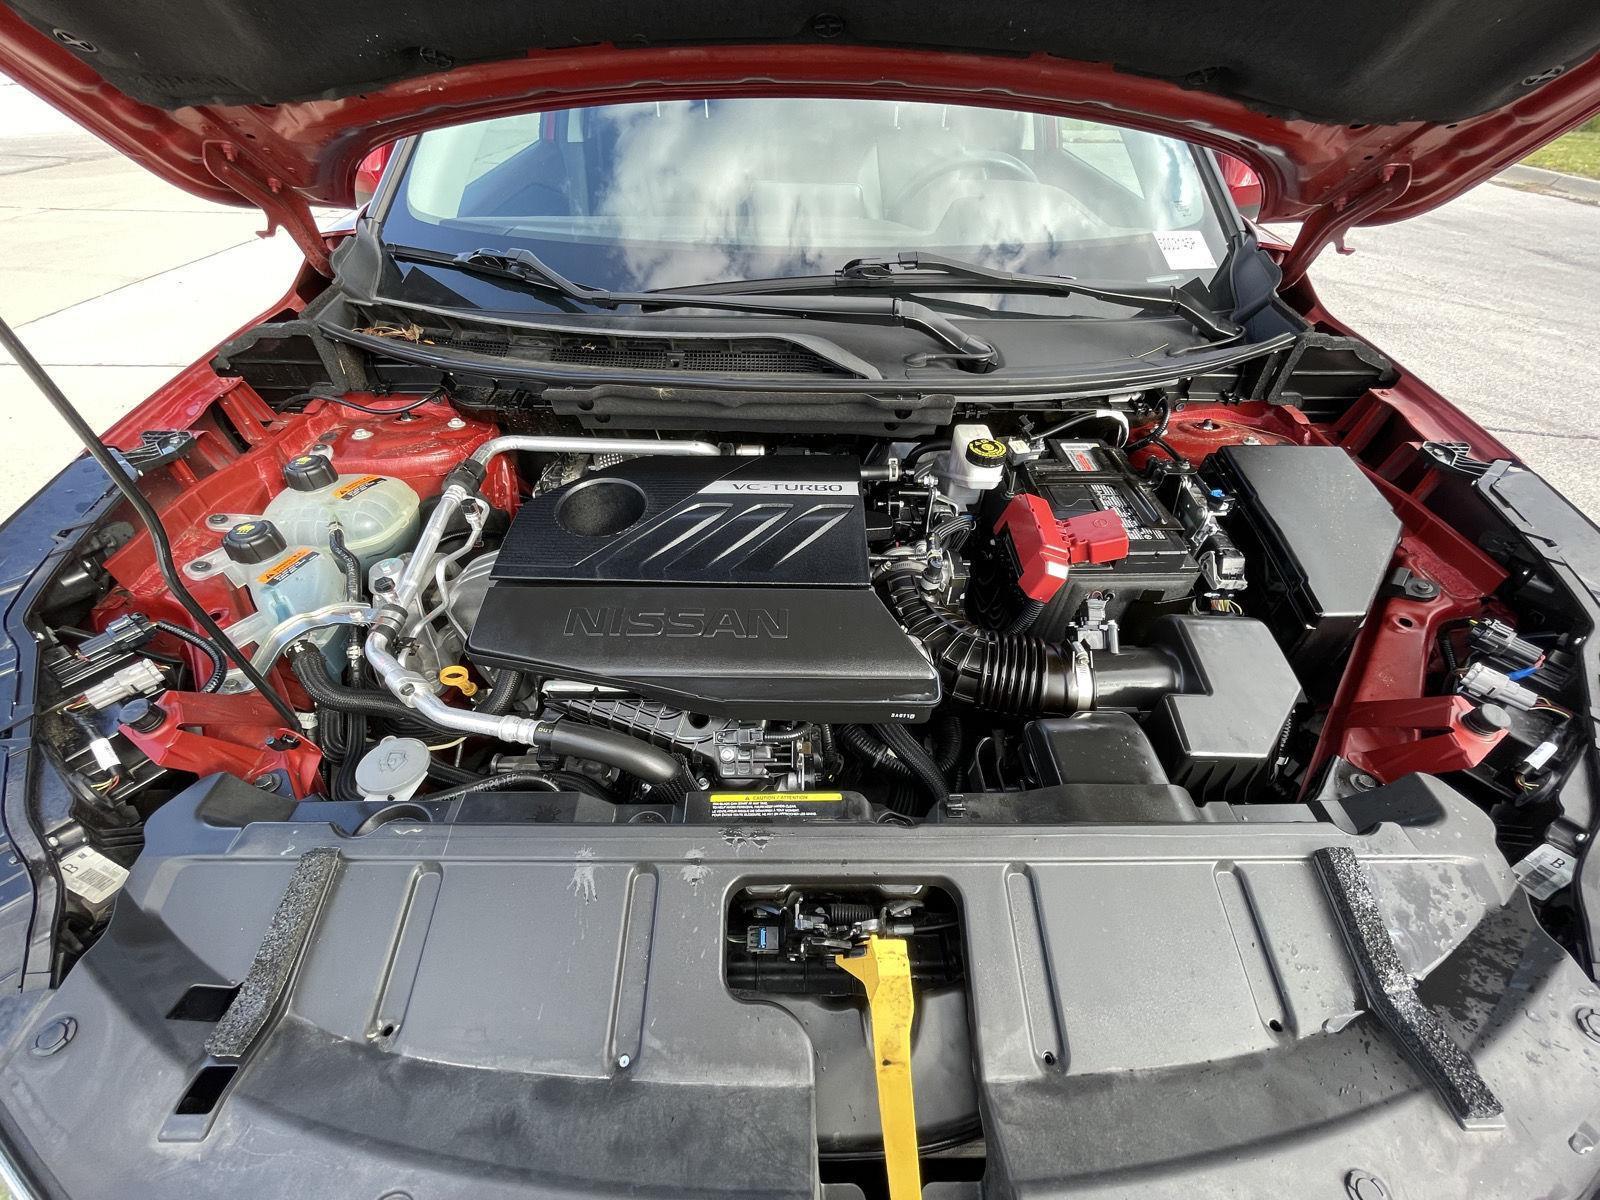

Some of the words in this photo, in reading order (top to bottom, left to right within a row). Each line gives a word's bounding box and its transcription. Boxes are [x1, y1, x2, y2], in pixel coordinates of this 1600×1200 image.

[733, 483, 843, 492] VC-TURBO
[563, 607, 789, 639] NISSAN
[1550, 858, 1566, 868] B
[62, 864, 79, 874] B
